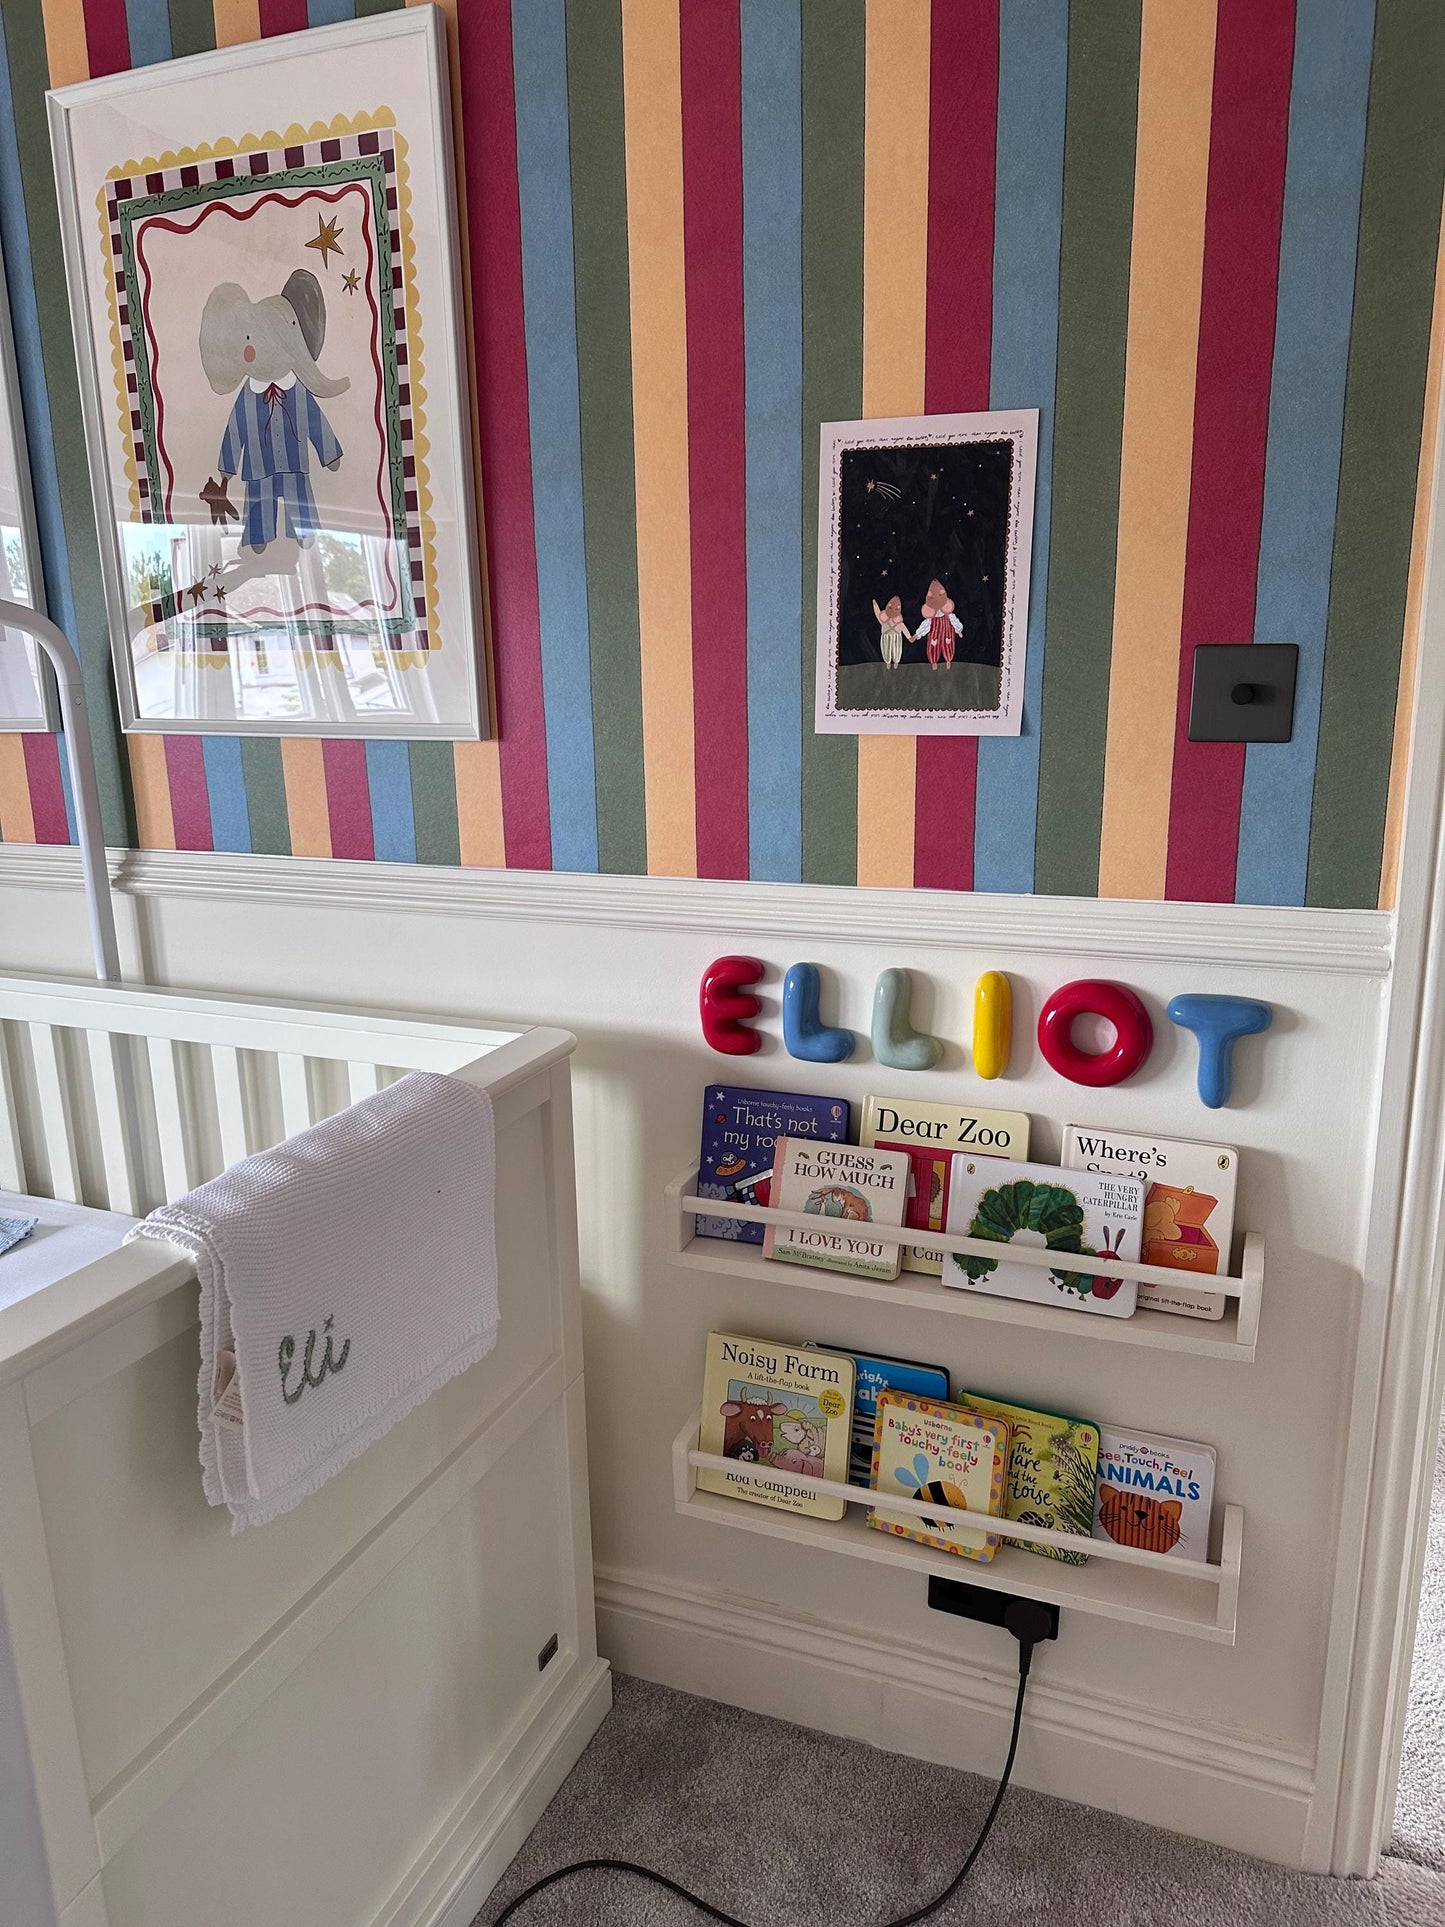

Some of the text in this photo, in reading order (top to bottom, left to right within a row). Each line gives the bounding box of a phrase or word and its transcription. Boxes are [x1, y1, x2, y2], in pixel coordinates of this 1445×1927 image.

[699, 955, 1273, 1110] ELLIOT
[733, 1106, 818, 1133] That's not
[875, 1108, 1011, 1148] Dear Zoo
[724, 1131, 749, 1150] my
[817, 1151, 874, 1171] GUESS
[1077, 1136, 1167, 1167] Where's
[794, 1162, 895, 1189] HOW MUCH
[1099, 1182, 1140, 1195] THE VERY
[1104, 1191, 1139, 1203] HUNGRY
[1082, 1196, 1139, 1212] CATERPILLAR
[788, 1229, 795, 1242] I
[800, 1231, 842, 1250] LOVE
[846, 1238, 884, 1257] YOU
[1196, 1304, 1212, 1312] book
[278, 1313, 350, 1405] Eli
[721, 1342, 840, 1384] Noisy Farm
[747, 1371, 811, 1391] A lift-the-flap book
[822, 1398, 840, 1410] Dear
[825, 1407, 838, 1416] Zoo
[888, 1418, 980, 1451] Baby's very first
[899, 1432, 978, 1466] touchy-feely
[1016, 1441, 1033, 1455] The
[1120, 1443, 1170, 1459] priddy books
[939, 1456, 970, 1473] book
[1164, 1461, 1193, 1480] Feel
[1007, 1471, 1038, 1485] nd the
